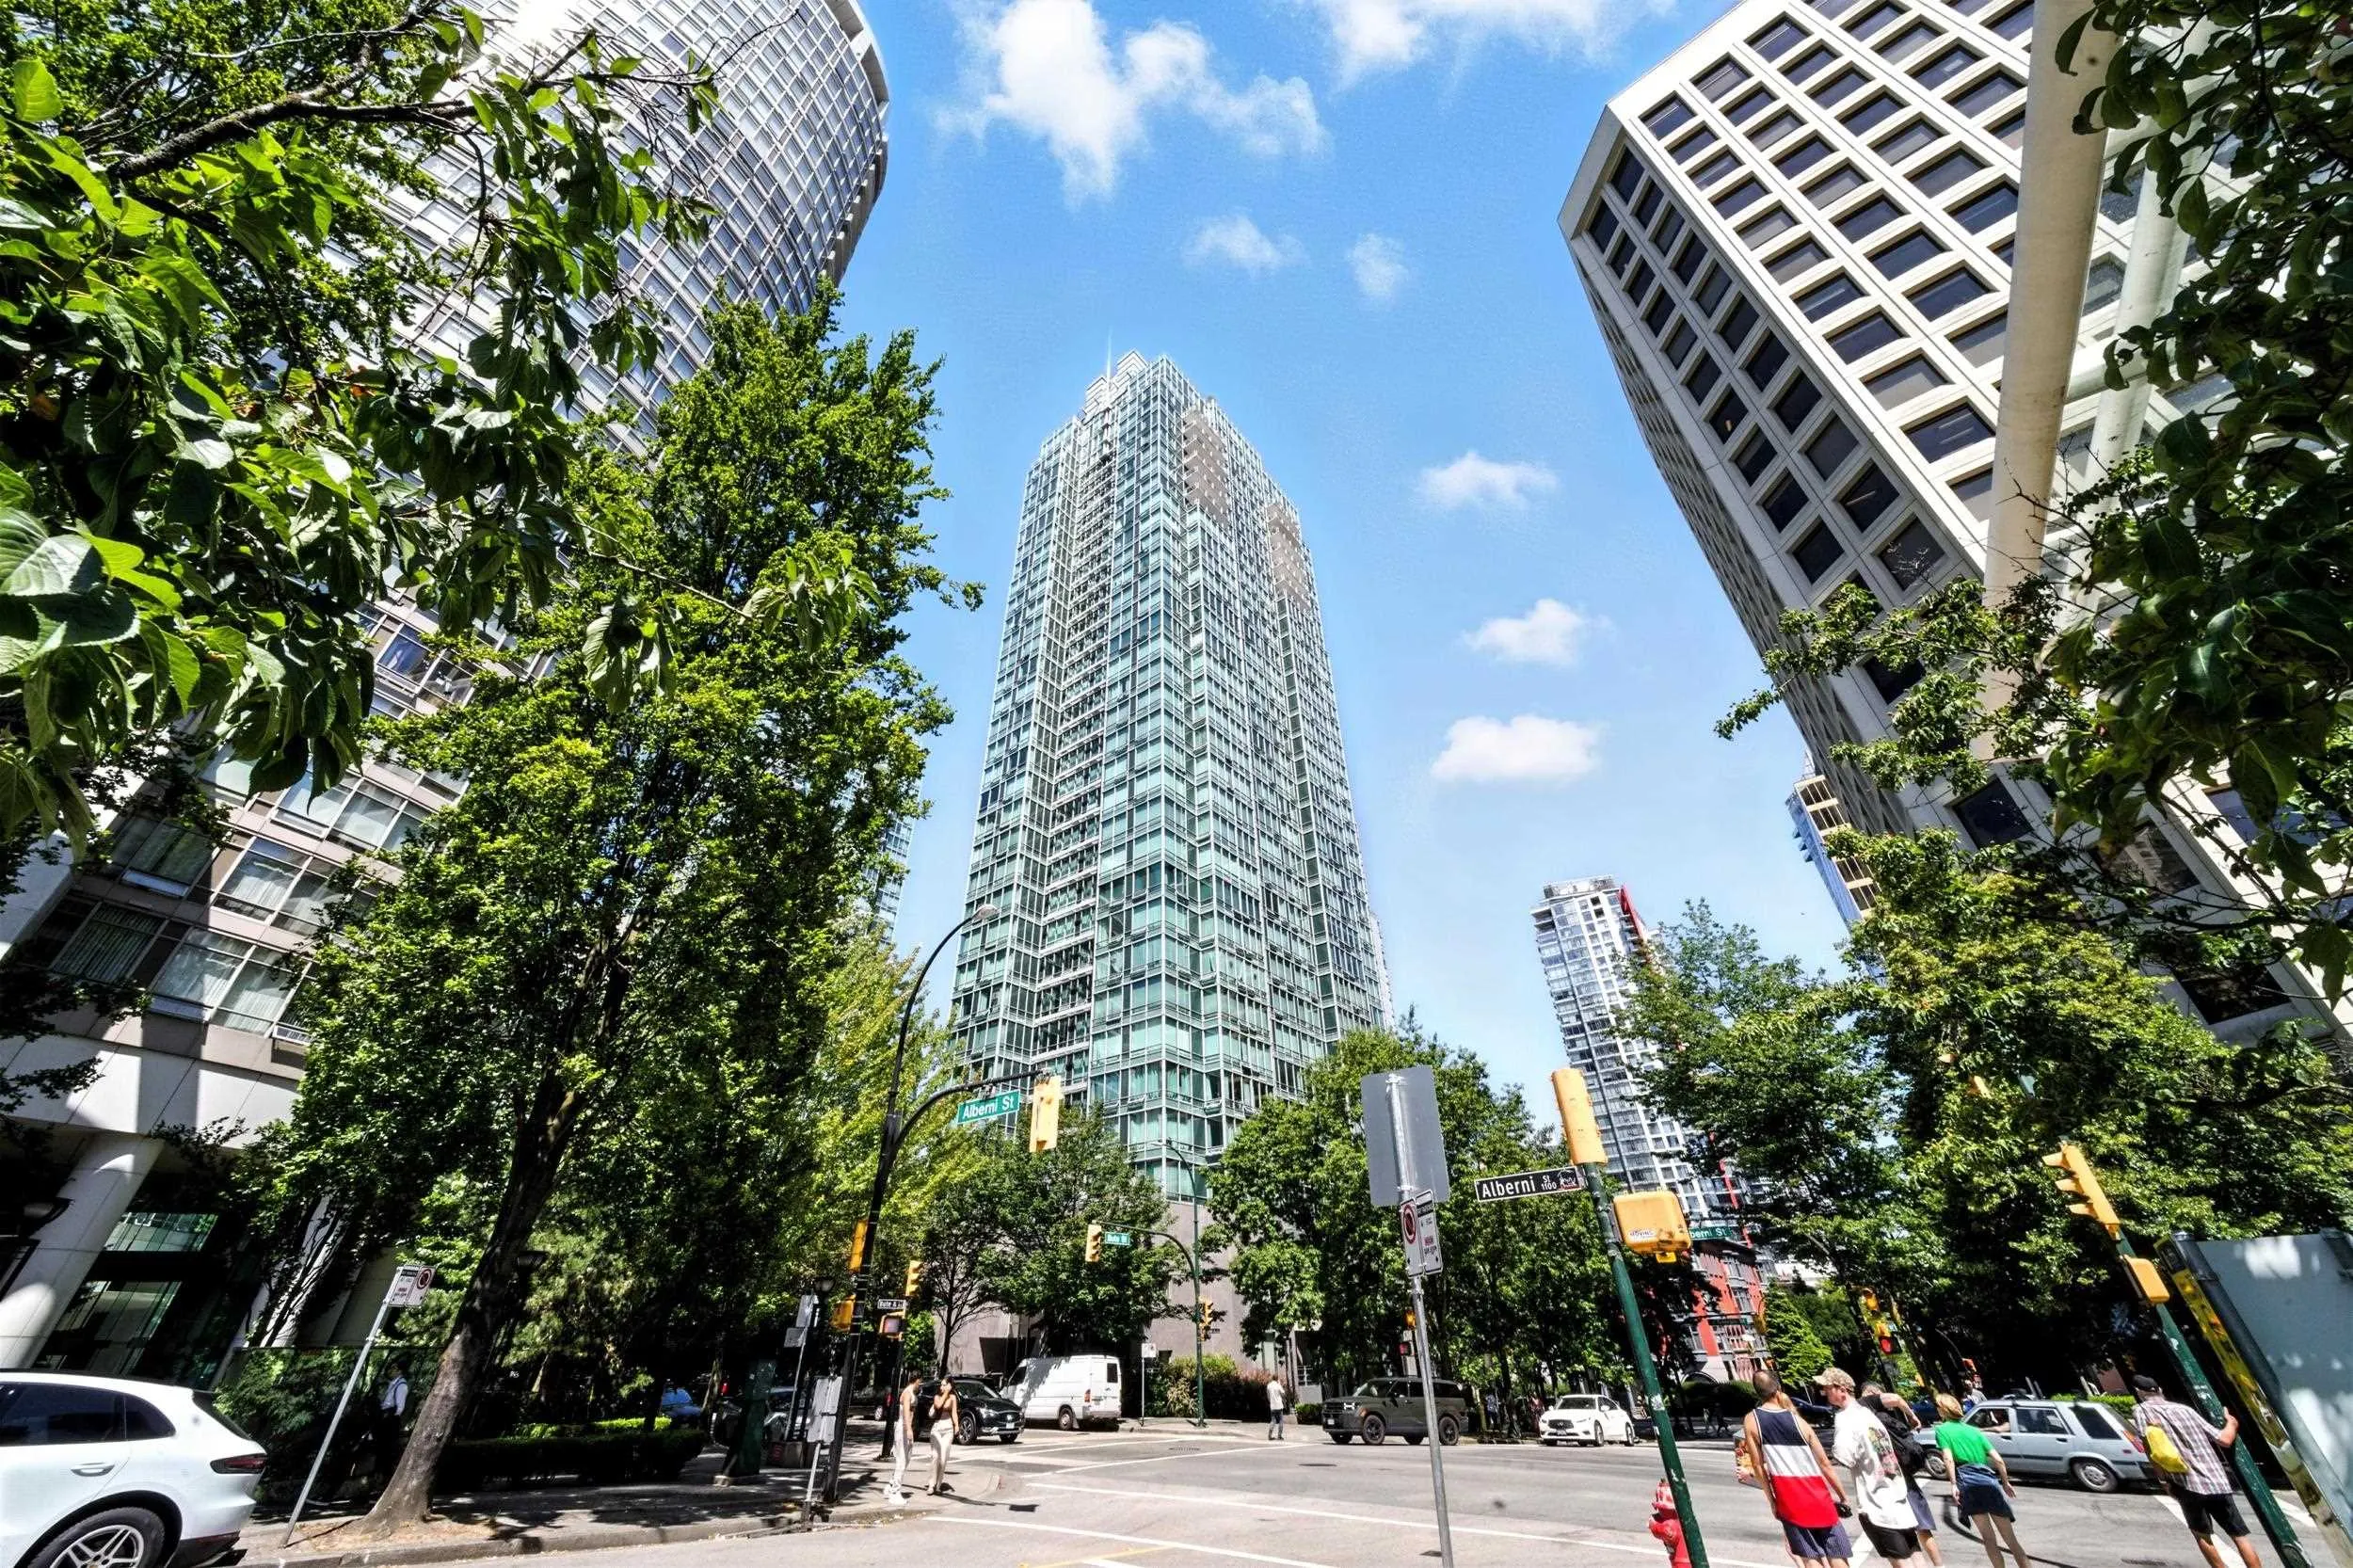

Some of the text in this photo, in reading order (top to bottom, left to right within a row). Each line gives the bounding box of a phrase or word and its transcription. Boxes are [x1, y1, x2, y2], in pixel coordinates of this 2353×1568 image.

[962, 1096, 1015, 1119] Alberni St
[1481, 1176, 1536, 1198] Alberni
[1541, 1181, 1558, 1191] 1100
[1689, 1227, 1727, 1239] berni St
